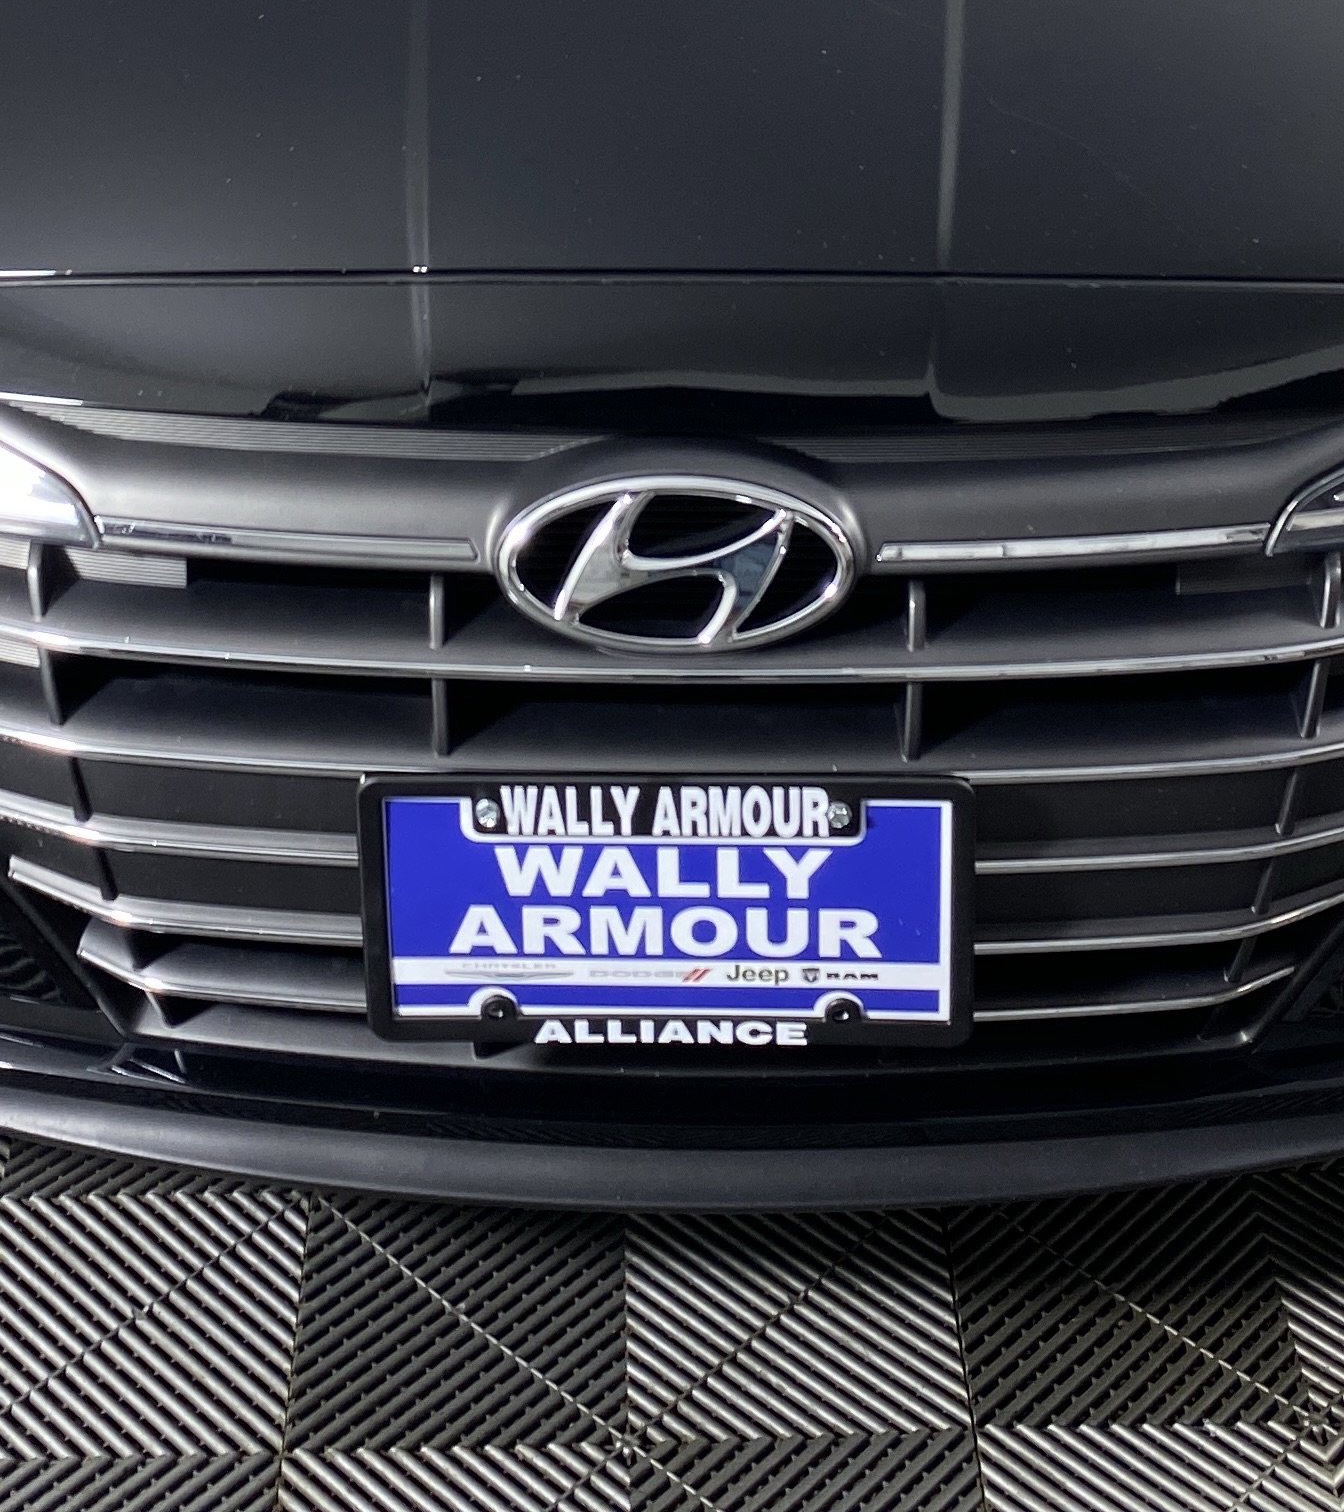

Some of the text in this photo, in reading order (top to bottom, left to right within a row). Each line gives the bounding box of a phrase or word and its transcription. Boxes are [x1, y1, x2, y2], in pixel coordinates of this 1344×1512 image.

[500, 785, 830, 838] WALLY ARMOUR
[494, 845, 833, 899] WALLY
[449, 905, 883, 958] ARMOUR
[726, 964, 789, 985] Jeep
[534, 1019, 809, 1046] ALLIANCE
